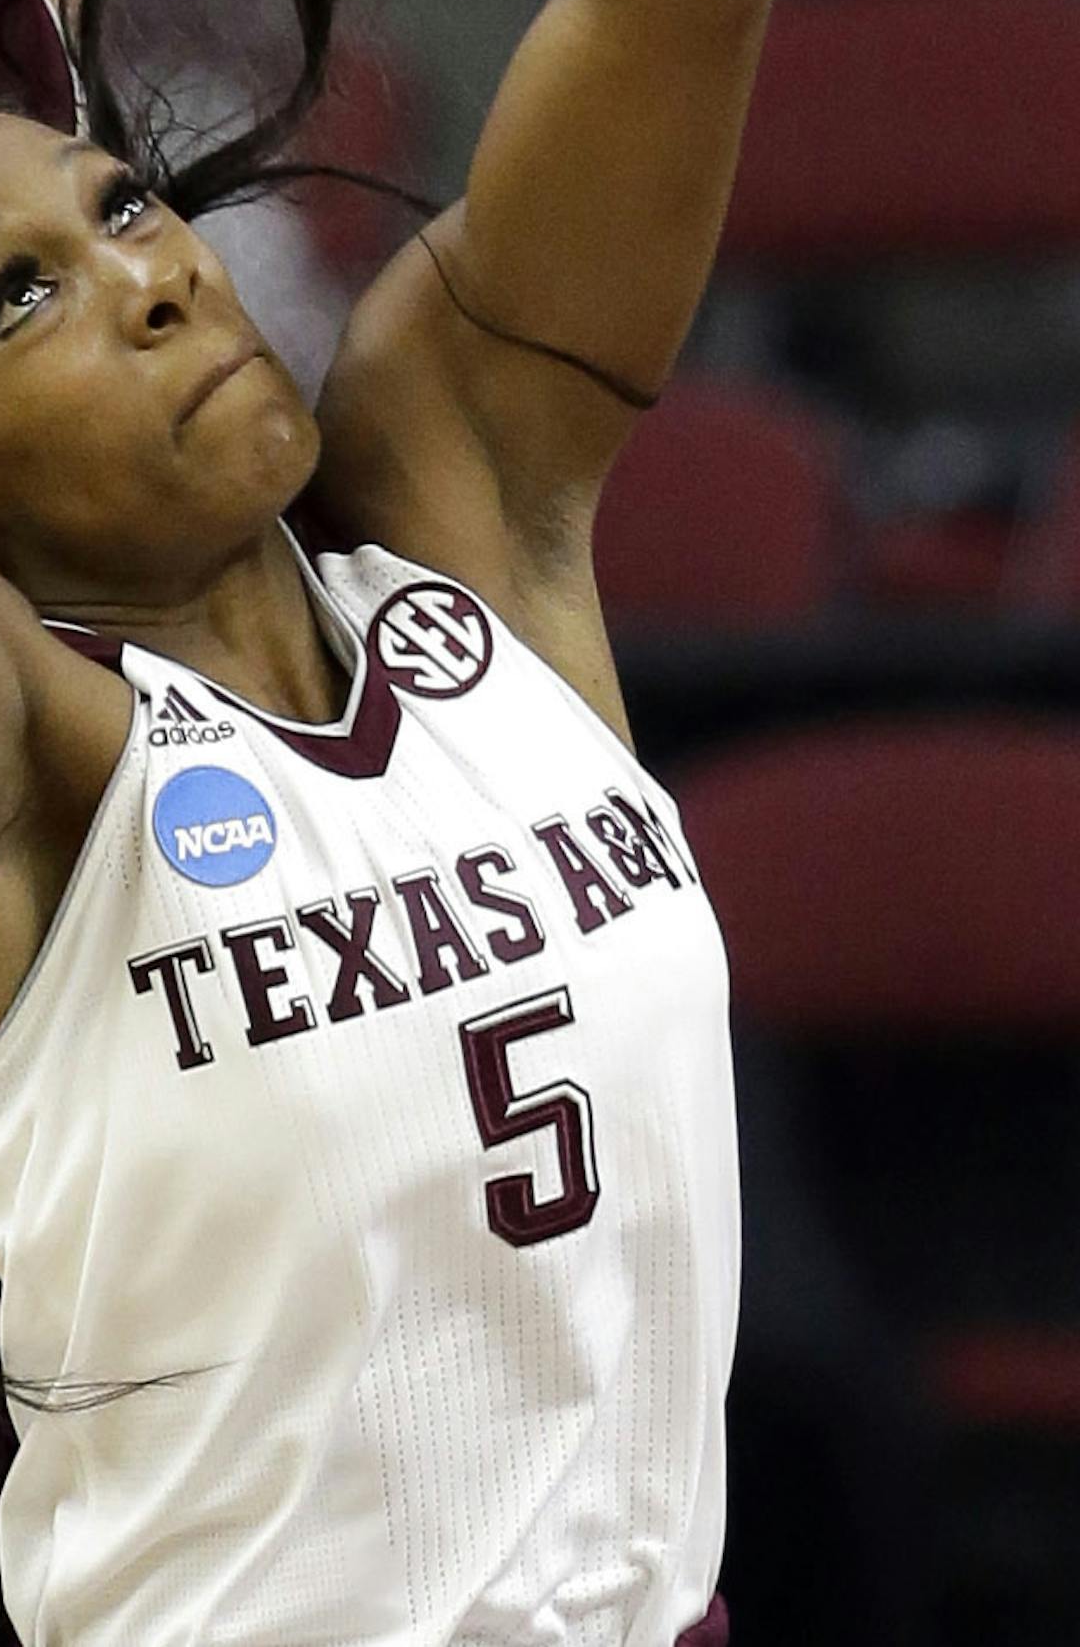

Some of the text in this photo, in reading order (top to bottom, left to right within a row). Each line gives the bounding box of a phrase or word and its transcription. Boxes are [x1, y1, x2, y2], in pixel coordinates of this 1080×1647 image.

[379, 590, 485, 688] SEC
[174, 814, 274, 861] NCAA
[128, 786, 696, 1070] TEXAS A&M
[458, 985, 601, 1248] 5
